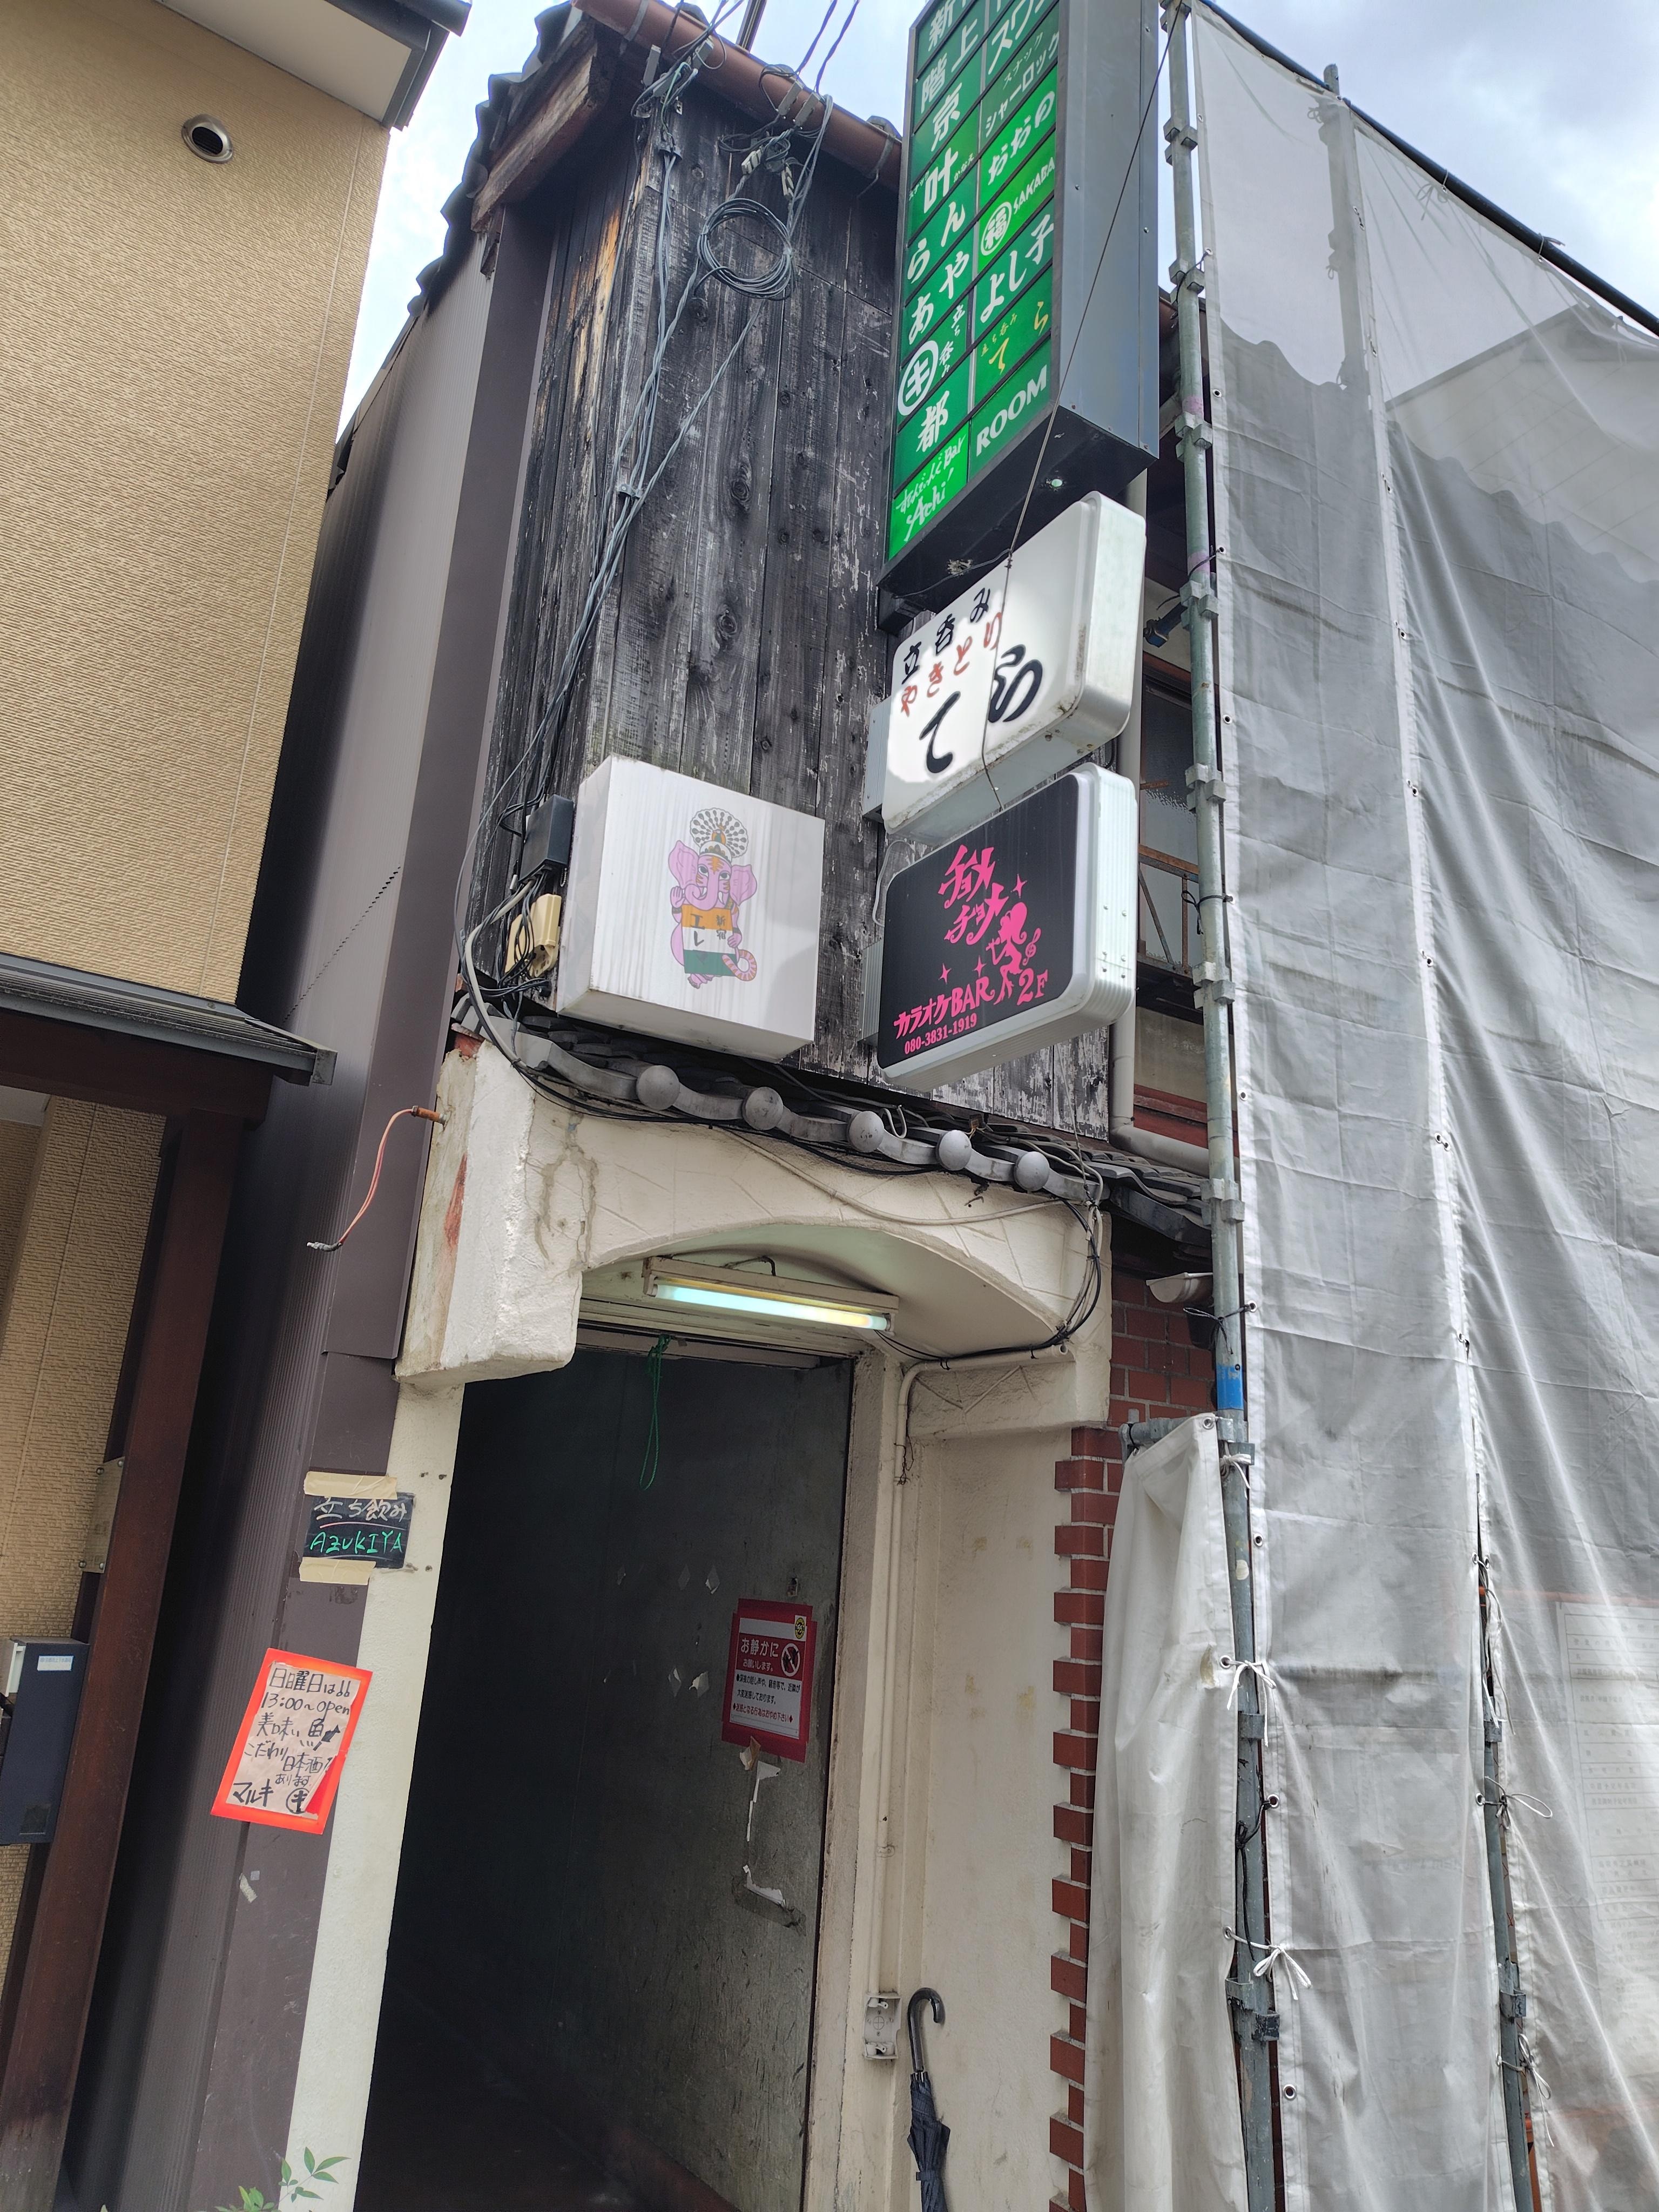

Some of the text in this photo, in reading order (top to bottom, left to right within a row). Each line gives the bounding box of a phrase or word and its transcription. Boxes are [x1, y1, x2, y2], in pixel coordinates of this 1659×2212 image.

[988, 0, 1045, 74] スワ
[986, 31, 1059, 138] シャーロック
[931, 83, 962, 152] 京
[988, 91, 1055, 185] おおの
[924, 147, 958, 213] 叶
[1013, 157, 1055, 214] SAKABA
[907, 202, 966, 284] らん
[981, 214, 1054, 323] よし子
[908, 251, 969, 345] あや
[916, 391, 949, 452] 都
[976, 365, 1047, 456] ROOM
[901, 612, 1003, 717] やきとり
[919, 644, 1043, 773] てら
[1017, 968, 1048, 1005] 2F
[905, 1013, 977, 1055] 080-3831-1919
[311, 1530, 402, 1554] AZUKIYA
[741, 1637, 779, 1657] お静かに
[743, 1659, 773, 1672] お願いします。
[244, 1741, 288, 1761] こだわり
[257, 1712, 299, 1741] 美味い
[233, 1779, 273, 1807] マルキ
[275, 1773, 311, 1787] あります
